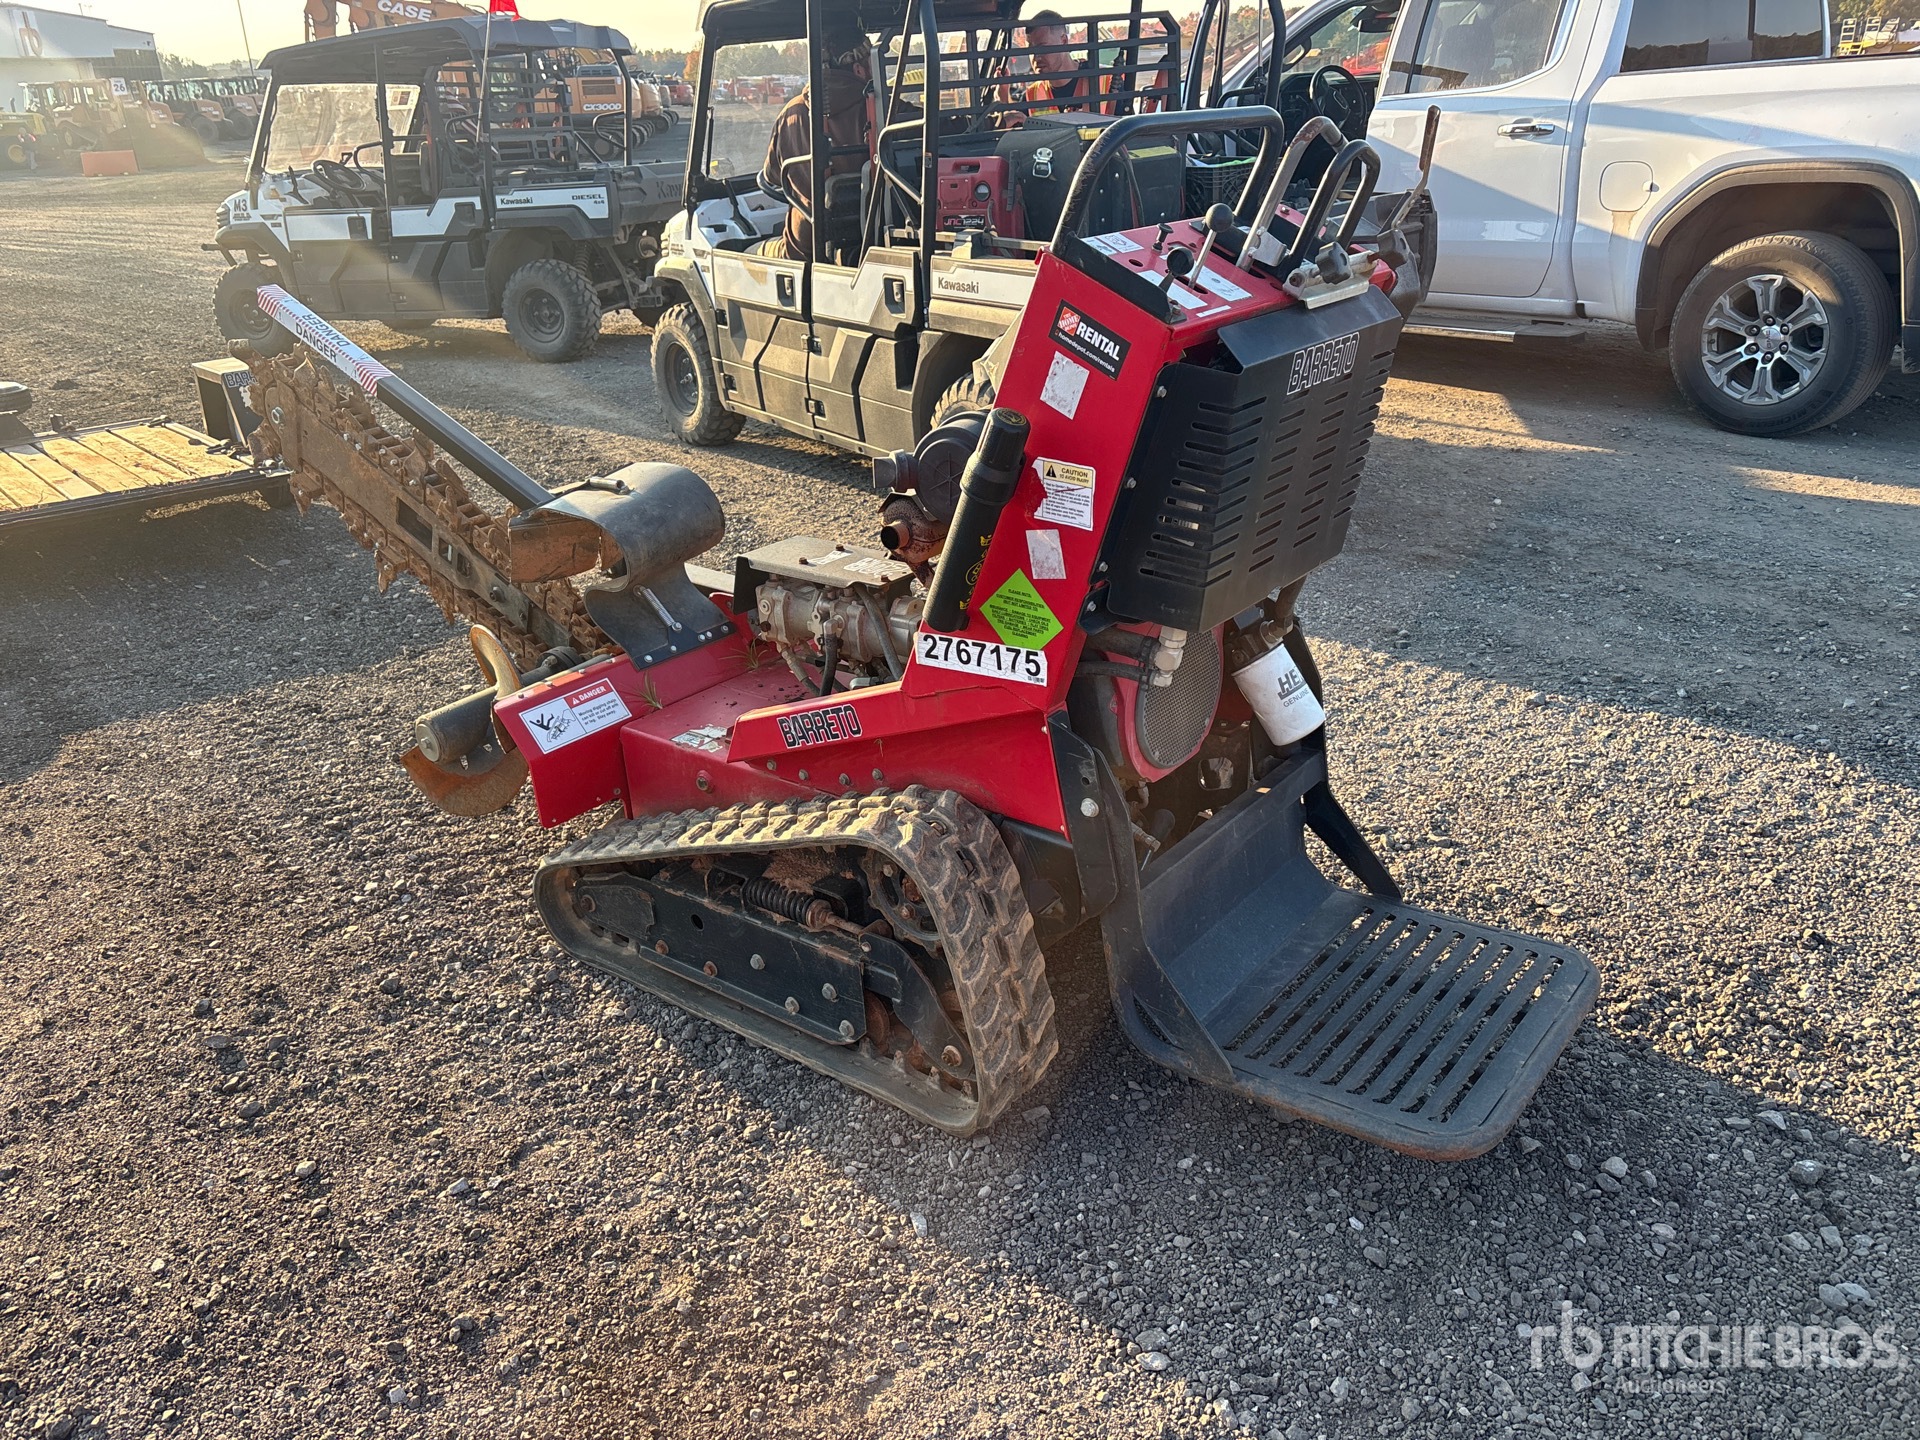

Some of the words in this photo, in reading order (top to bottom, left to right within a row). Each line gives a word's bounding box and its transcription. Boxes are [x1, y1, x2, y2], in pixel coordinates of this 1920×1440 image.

[378, 0, 432, 21] CASE
[113, 84, 125, 92] 26
[234, 200, 248, 212] M3
[500, 197, 533, 205] Kawasaki
[938, 277, 979, 294] Kawasaki
[296, 322, 337, 363] DANGER
[1076, 321, 1120, 361] RENTAL
[1058, 332, 1116, 373] homedepot.com/rentals
[1287, 331, 1360, 395] BARRETO
[1061, 468, 1088, 478] CAUTION
[922, 634, 1040, 677] 2767175
[578, 686, 606, 701] DANGER
[1282, 688, 1310, 708] GENUINE
[776, 704, 863, 749] BARRETO
